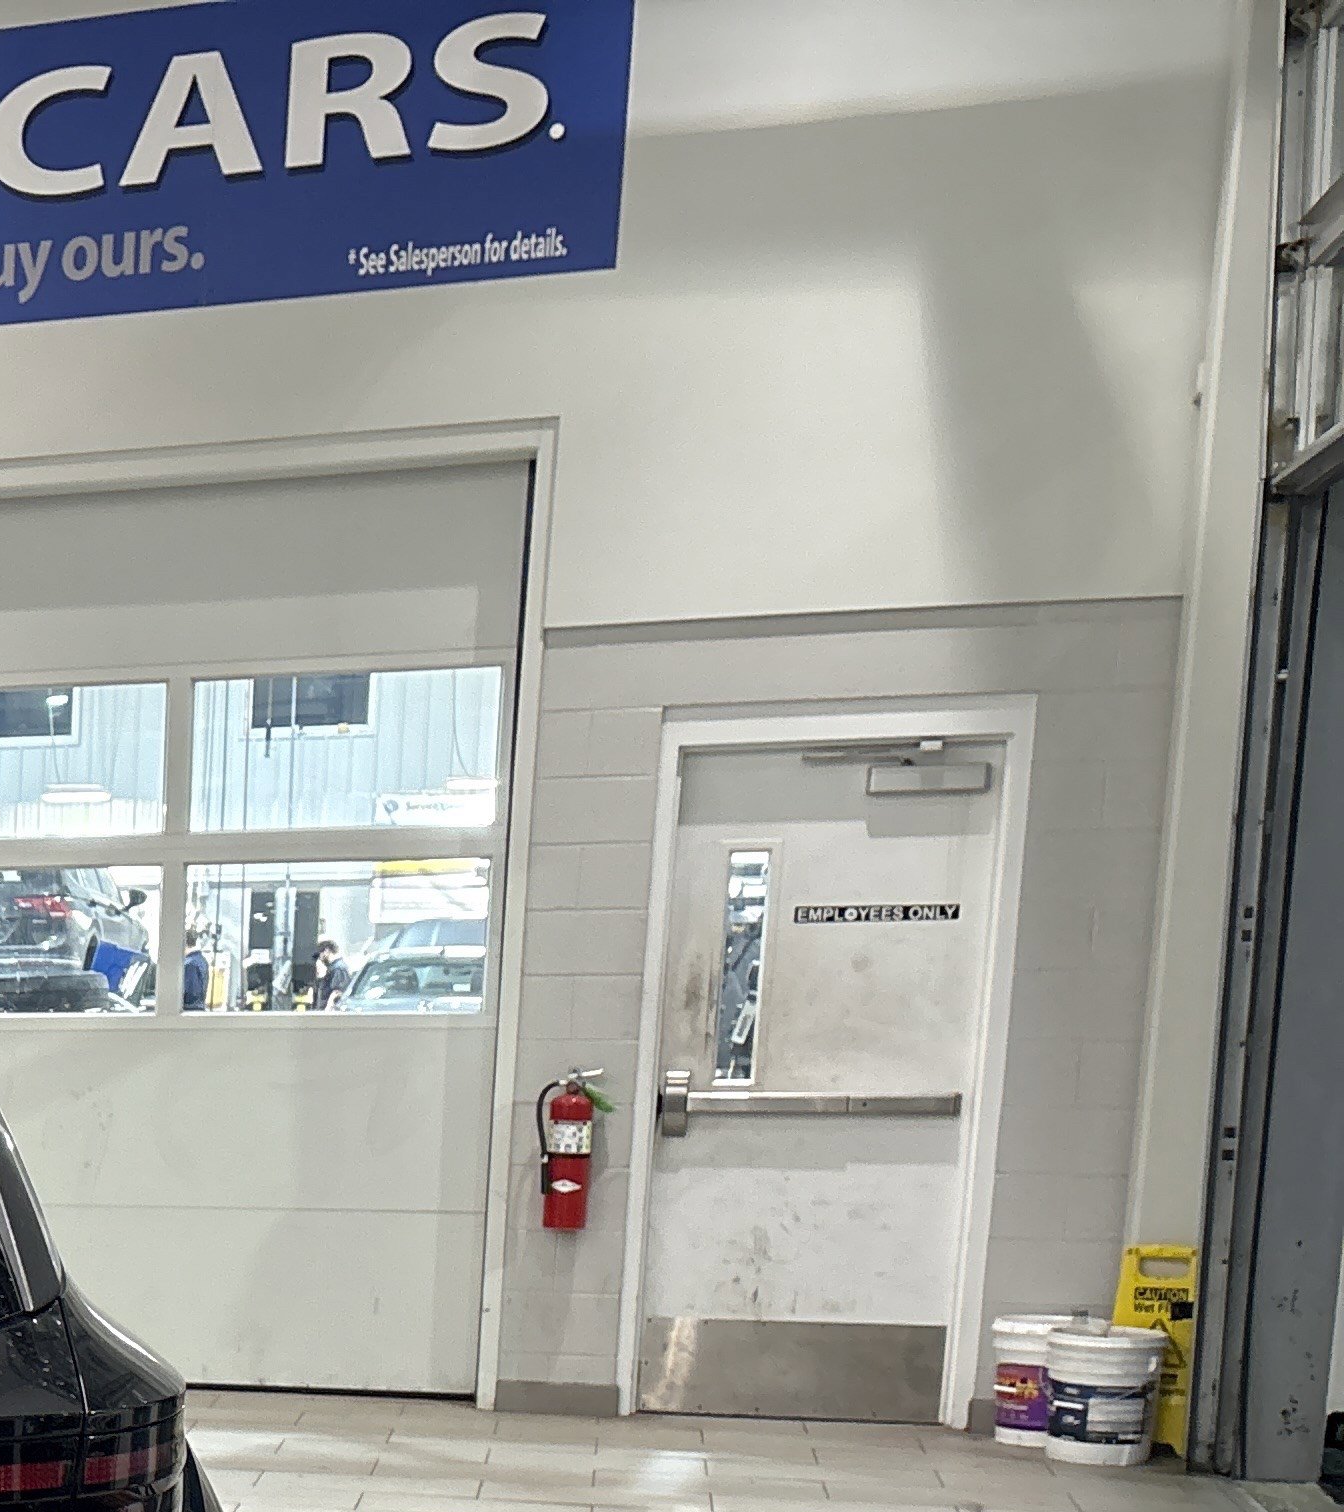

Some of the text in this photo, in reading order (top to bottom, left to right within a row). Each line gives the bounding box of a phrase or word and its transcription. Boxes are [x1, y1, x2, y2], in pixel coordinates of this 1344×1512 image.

[61, 225, 206, 282] ours.
[388, 241, 482, 277] Salesperson
[483, 232, 509, 264] for
[509, 226, 569, 261] details.
[797, 905, 956, 922] EMPLOYEES ONLY
[1135, 1287, 1188, 1301] CAUTION
